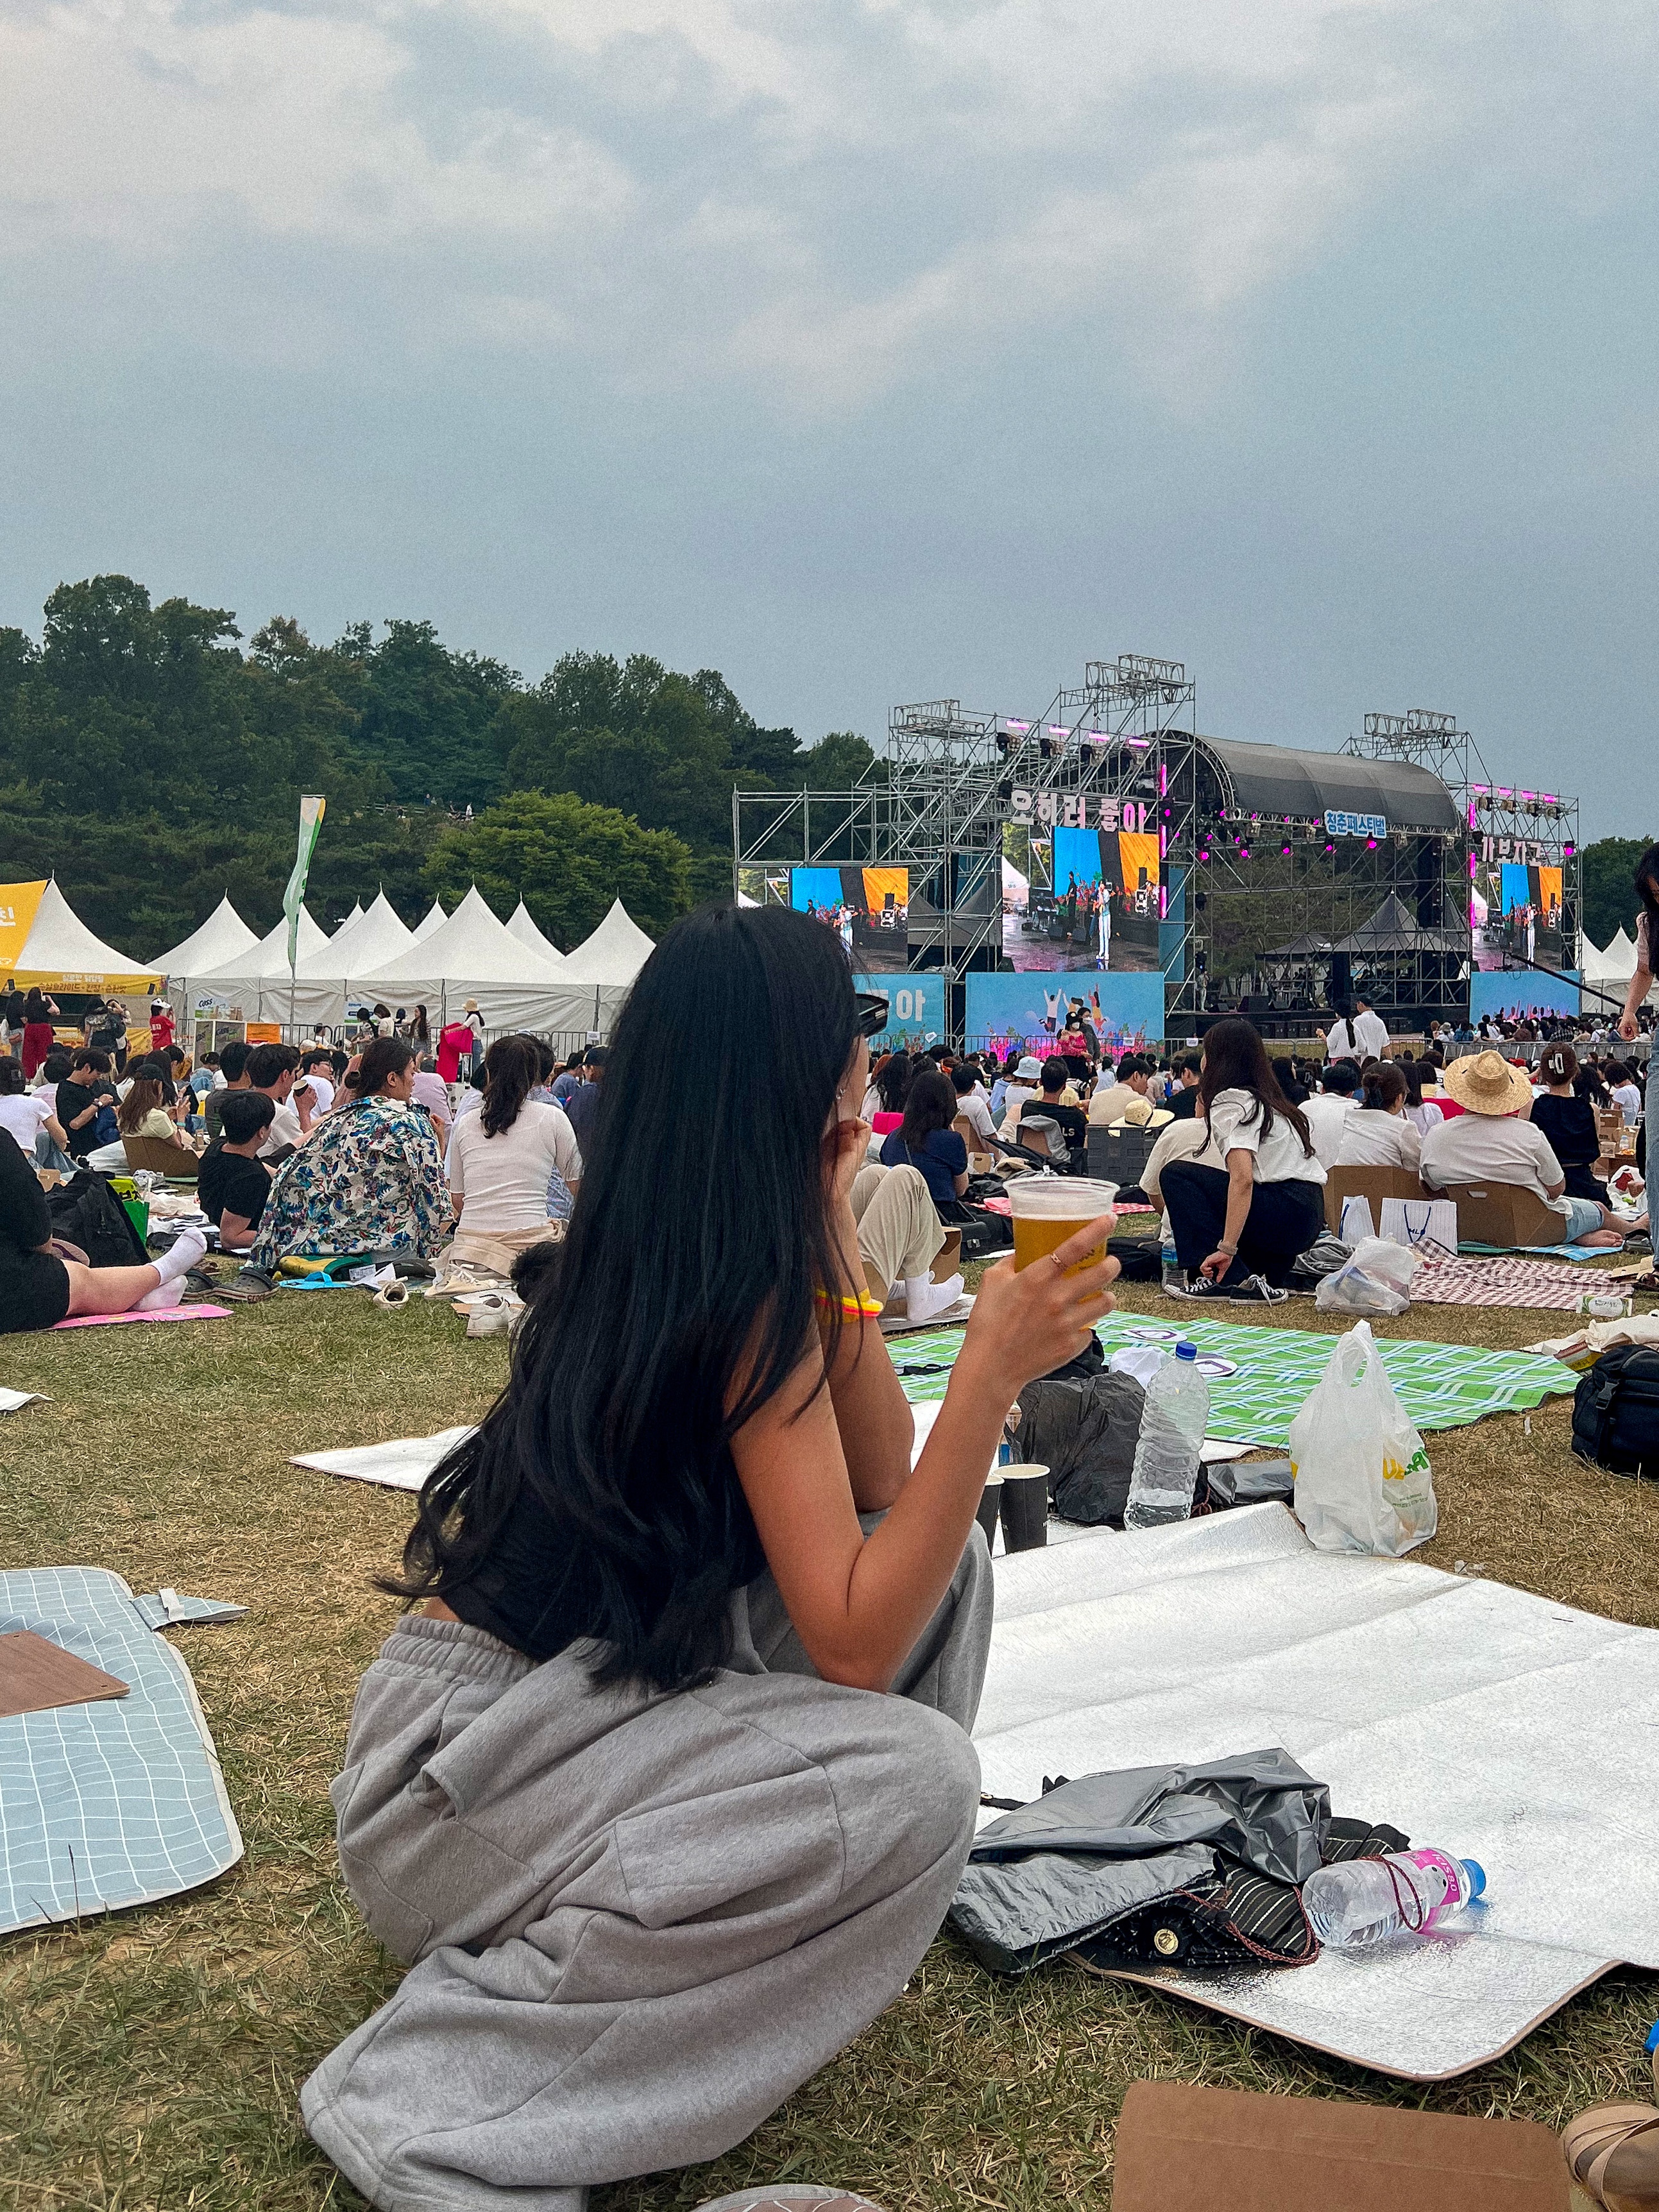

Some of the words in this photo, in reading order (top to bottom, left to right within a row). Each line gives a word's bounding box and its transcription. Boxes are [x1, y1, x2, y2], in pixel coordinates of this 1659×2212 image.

[1011, 790, 1085, 830] 오히려
[1099, 798, 1147, 834] 좋아
[1326, 812, 1385, 837] 청춘페스티벌
